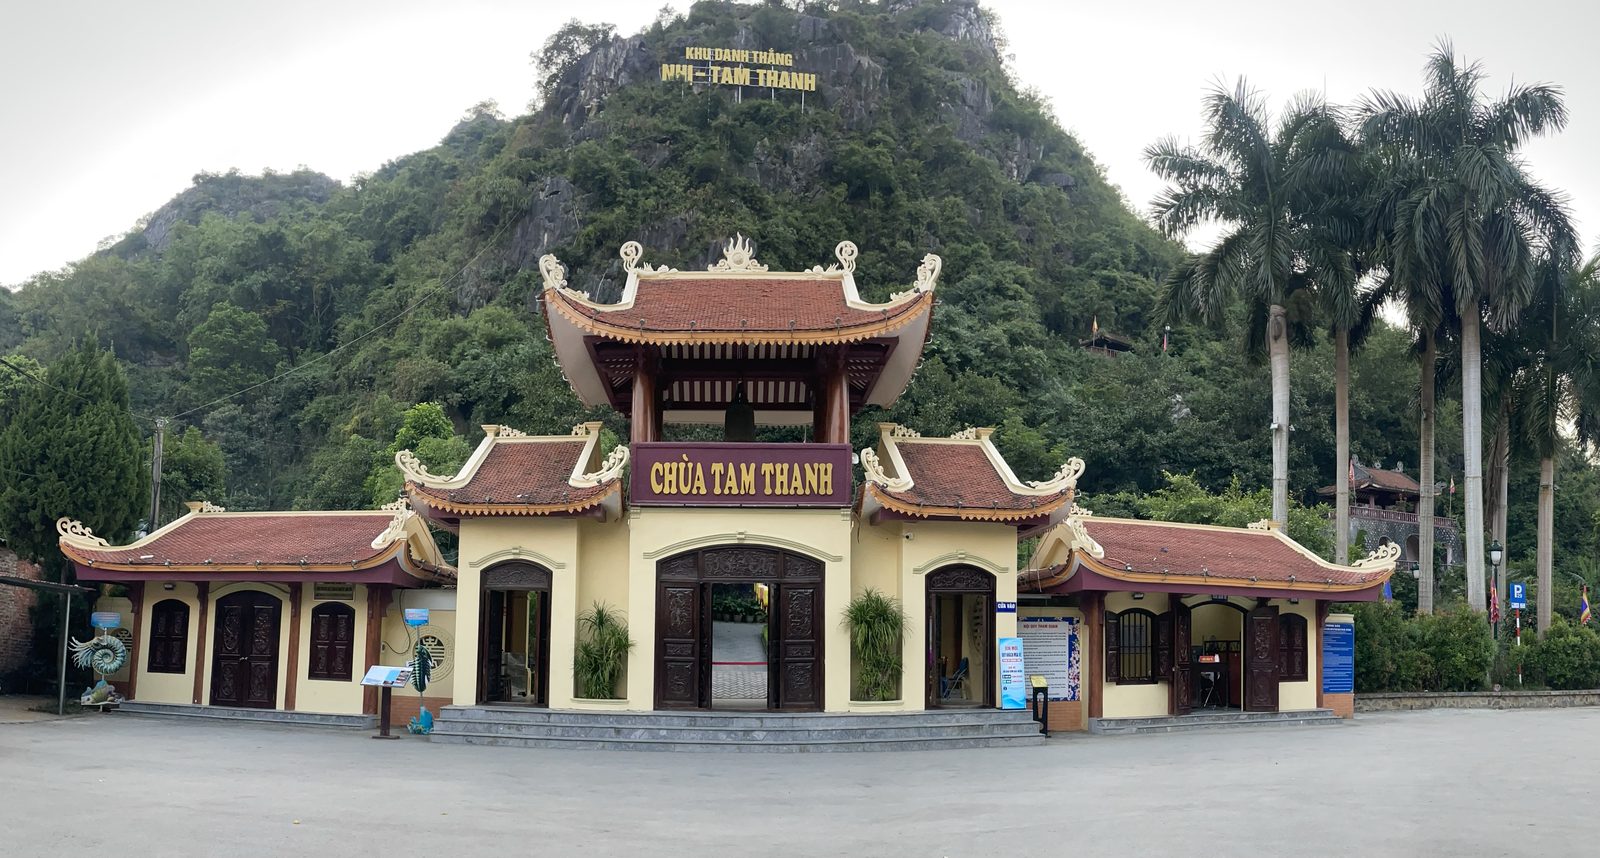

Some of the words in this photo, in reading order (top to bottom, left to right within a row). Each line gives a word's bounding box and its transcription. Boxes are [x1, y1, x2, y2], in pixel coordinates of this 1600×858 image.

[685, 47, 711, 60] KHU
[715, 48, 749, 62] DANH
[752, 48, 793, 66] THẮNG
[710, 66, 750, 86] TAM
[756, 69, 816, 91] THANH
[650, 453, 707, 495] CHÙA
[711, 462, 756, 495] TAM
[761, 462, 833, 495] THANH
